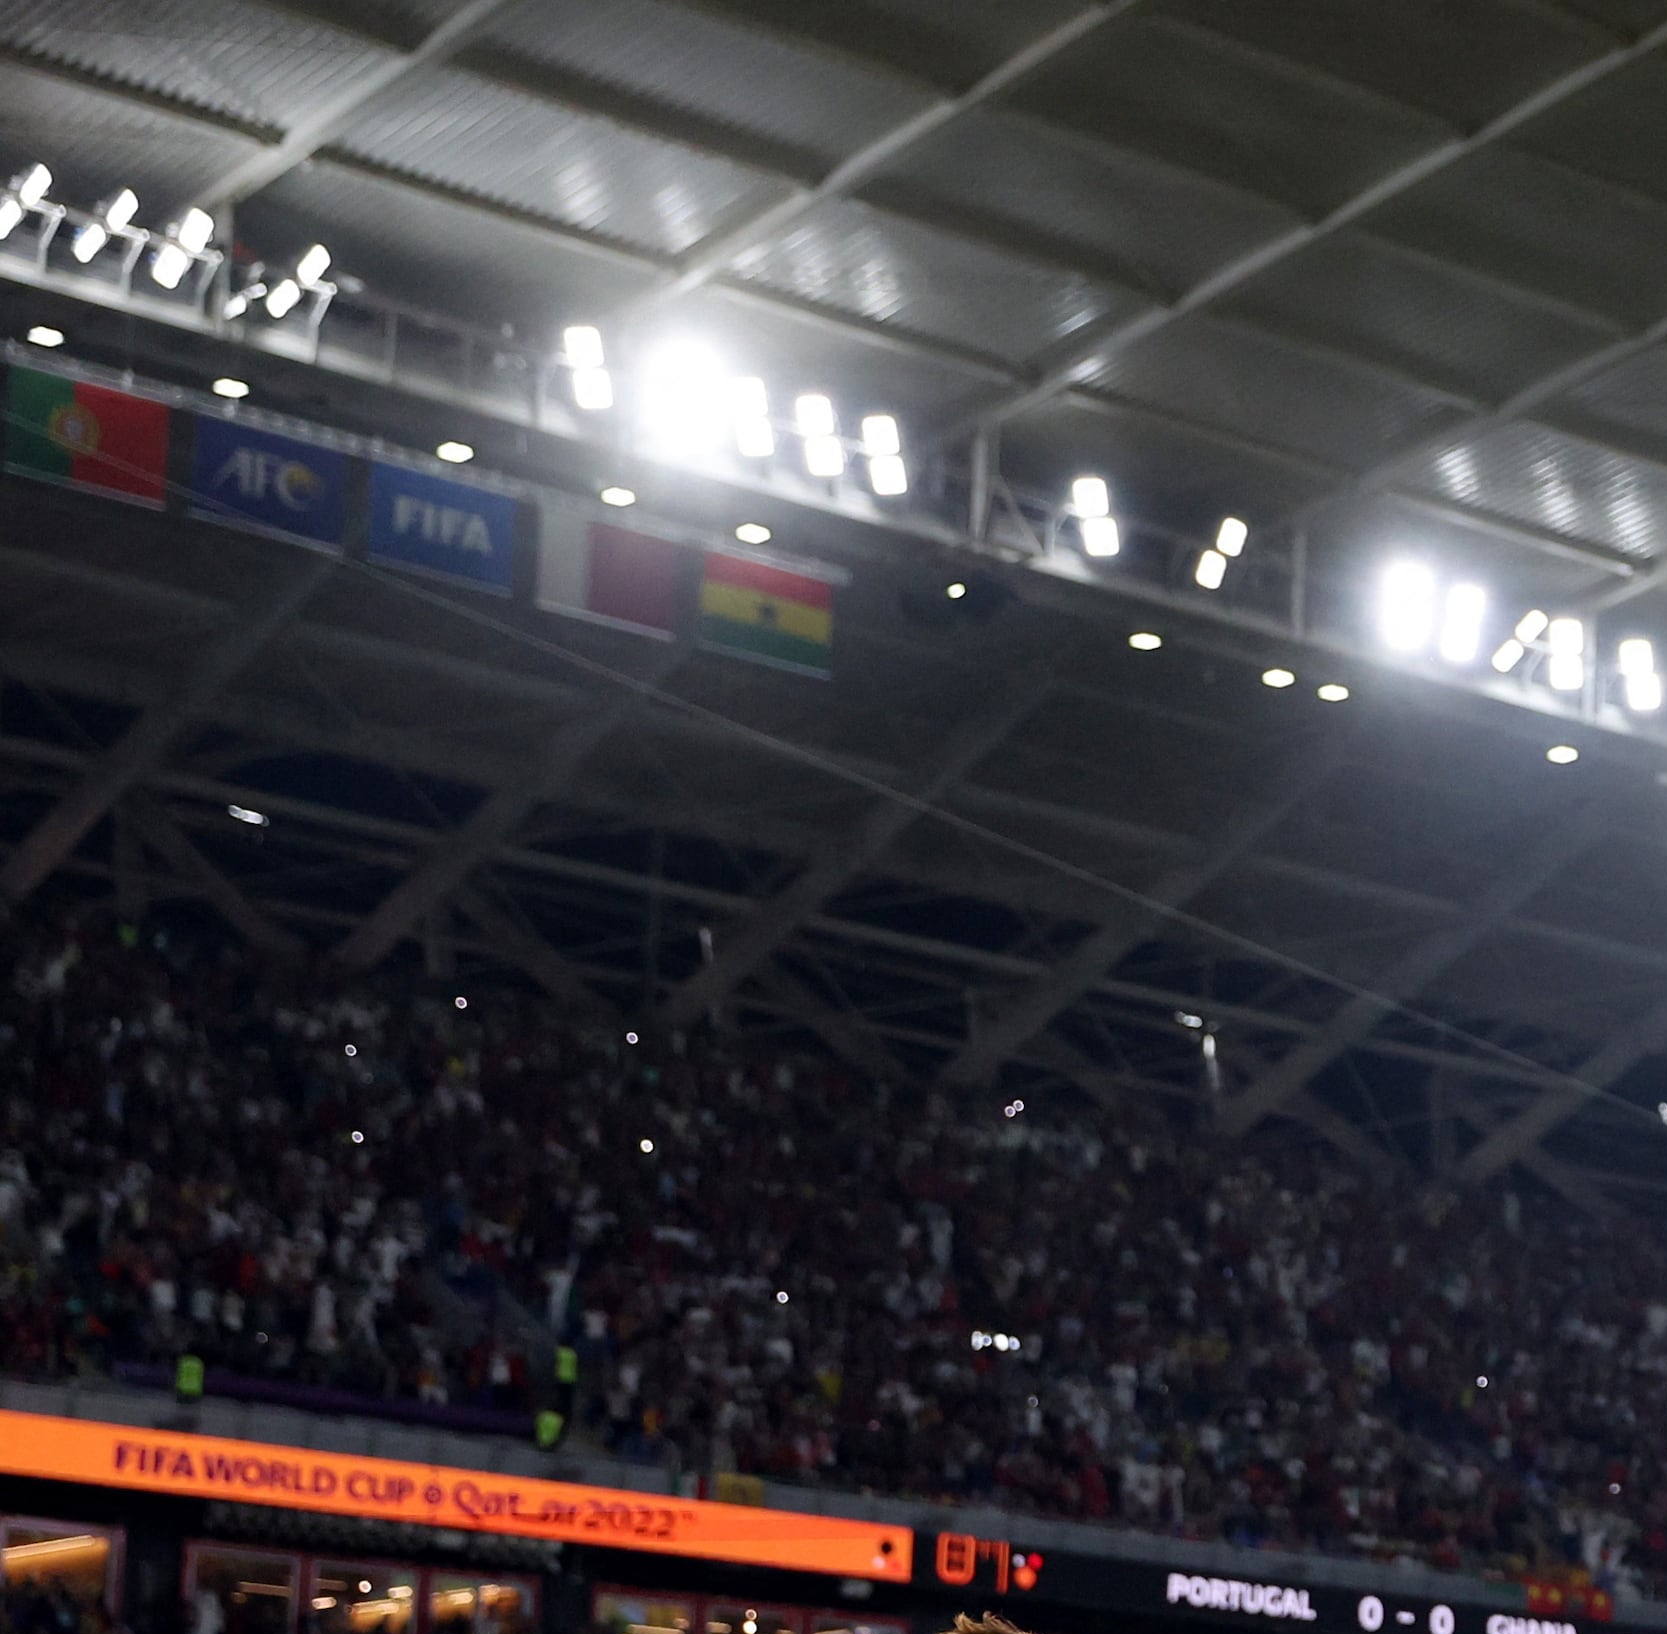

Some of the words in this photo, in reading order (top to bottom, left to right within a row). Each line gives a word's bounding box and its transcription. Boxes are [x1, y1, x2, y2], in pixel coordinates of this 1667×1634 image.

[208, 446, 321, 511] AFC
[393, 496, 493, 555] FIFA
[113, 1440, 195, 1477] FIFA
[203, 1454, 337, 1496] WORLD
[346, 1470, 415, 1502] CUP
[1167, 1573, 1317, 1620] PORTUGAL
[1357, 1595, 1384, 1632] 0
